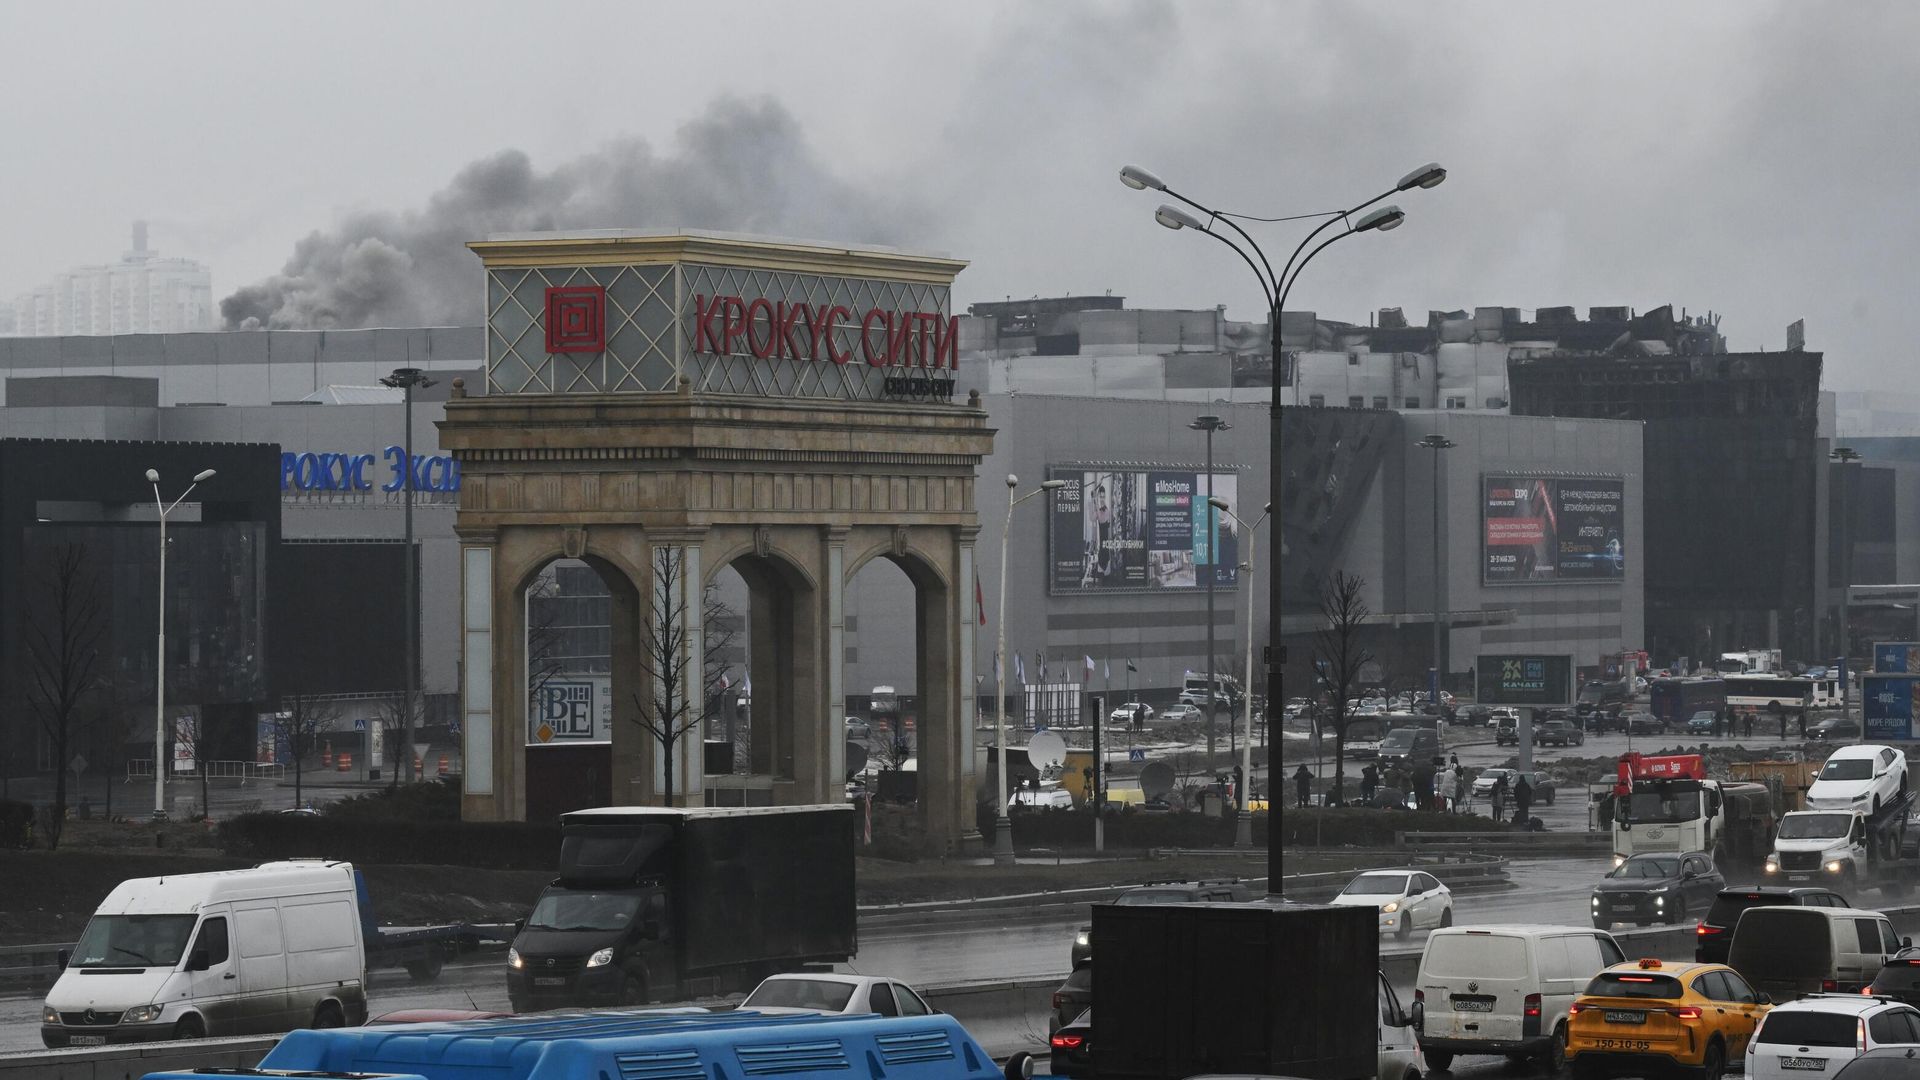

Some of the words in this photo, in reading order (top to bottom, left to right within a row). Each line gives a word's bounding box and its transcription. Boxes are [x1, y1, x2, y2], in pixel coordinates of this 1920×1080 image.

[695, 294, 852, 366] КРОКУС
[862, 308, 960, 371] СИТИ
[1058, 479, 1080, 490] OCUS
[1867, 718, 1883, 727] МОРЕ
[1884, 718, 1907, 727] РЯДОМ
[1595, 1039, 1651, 1050] 150-10-05
